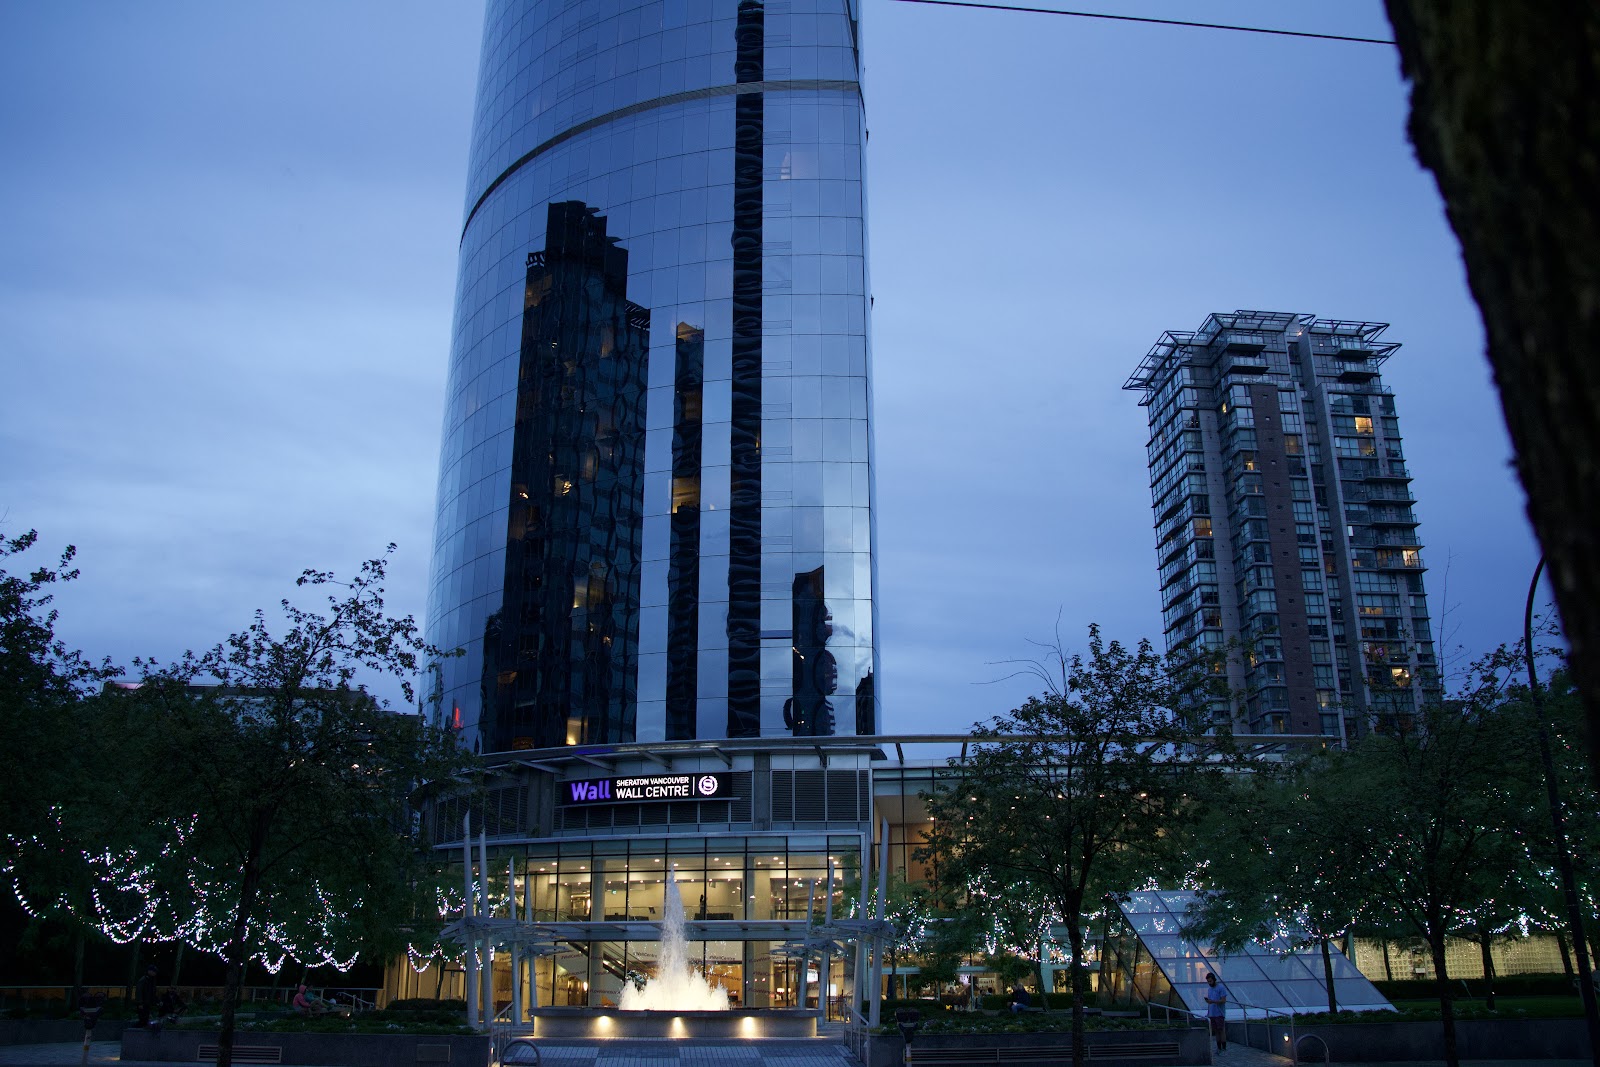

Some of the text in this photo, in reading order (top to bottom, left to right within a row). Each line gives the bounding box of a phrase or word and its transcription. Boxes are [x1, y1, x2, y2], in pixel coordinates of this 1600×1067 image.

[616, 776, 690, 787] SHERATON VANCOUVER
[571, 780, 611, 801] Wall
[616, 785, 690, 799] WALL CENTRE
